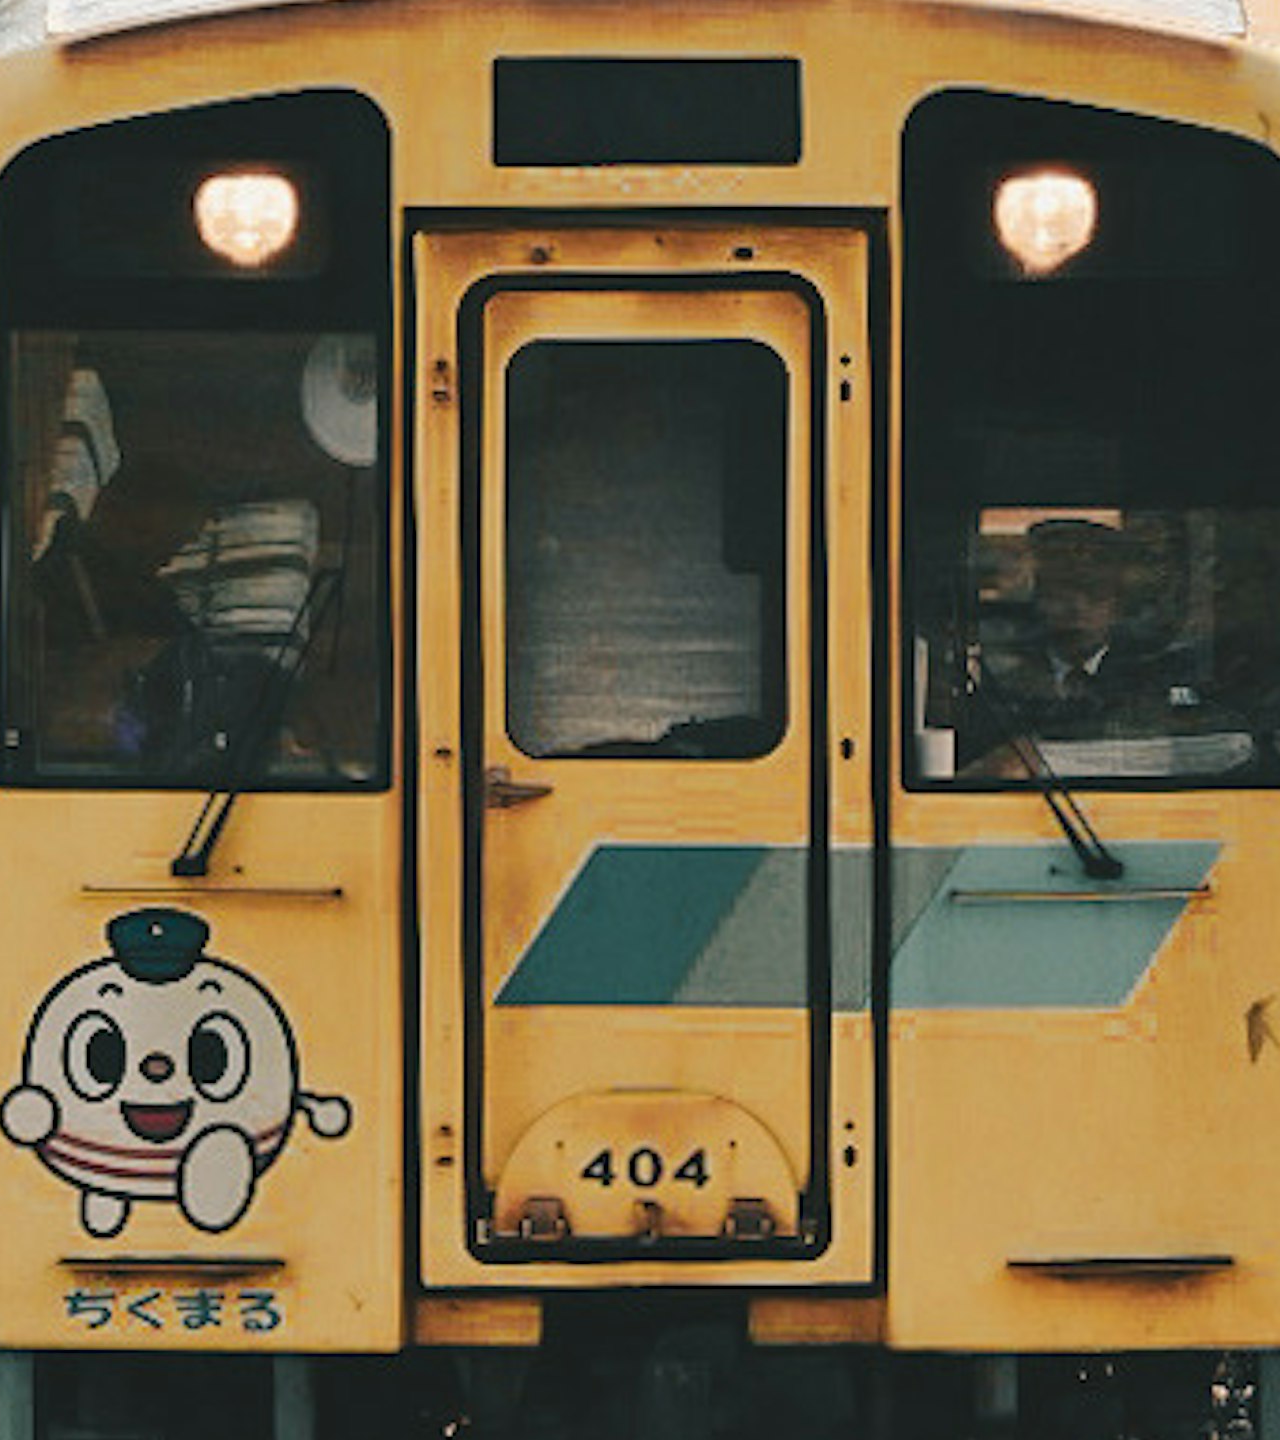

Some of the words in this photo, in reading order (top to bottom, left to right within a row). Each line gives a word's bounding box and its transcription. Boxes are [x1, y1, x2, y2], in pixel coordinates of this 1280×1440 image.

[581, 1148, 710, 1187] 404
[64, 1291, 281, 1330] ちくまる
